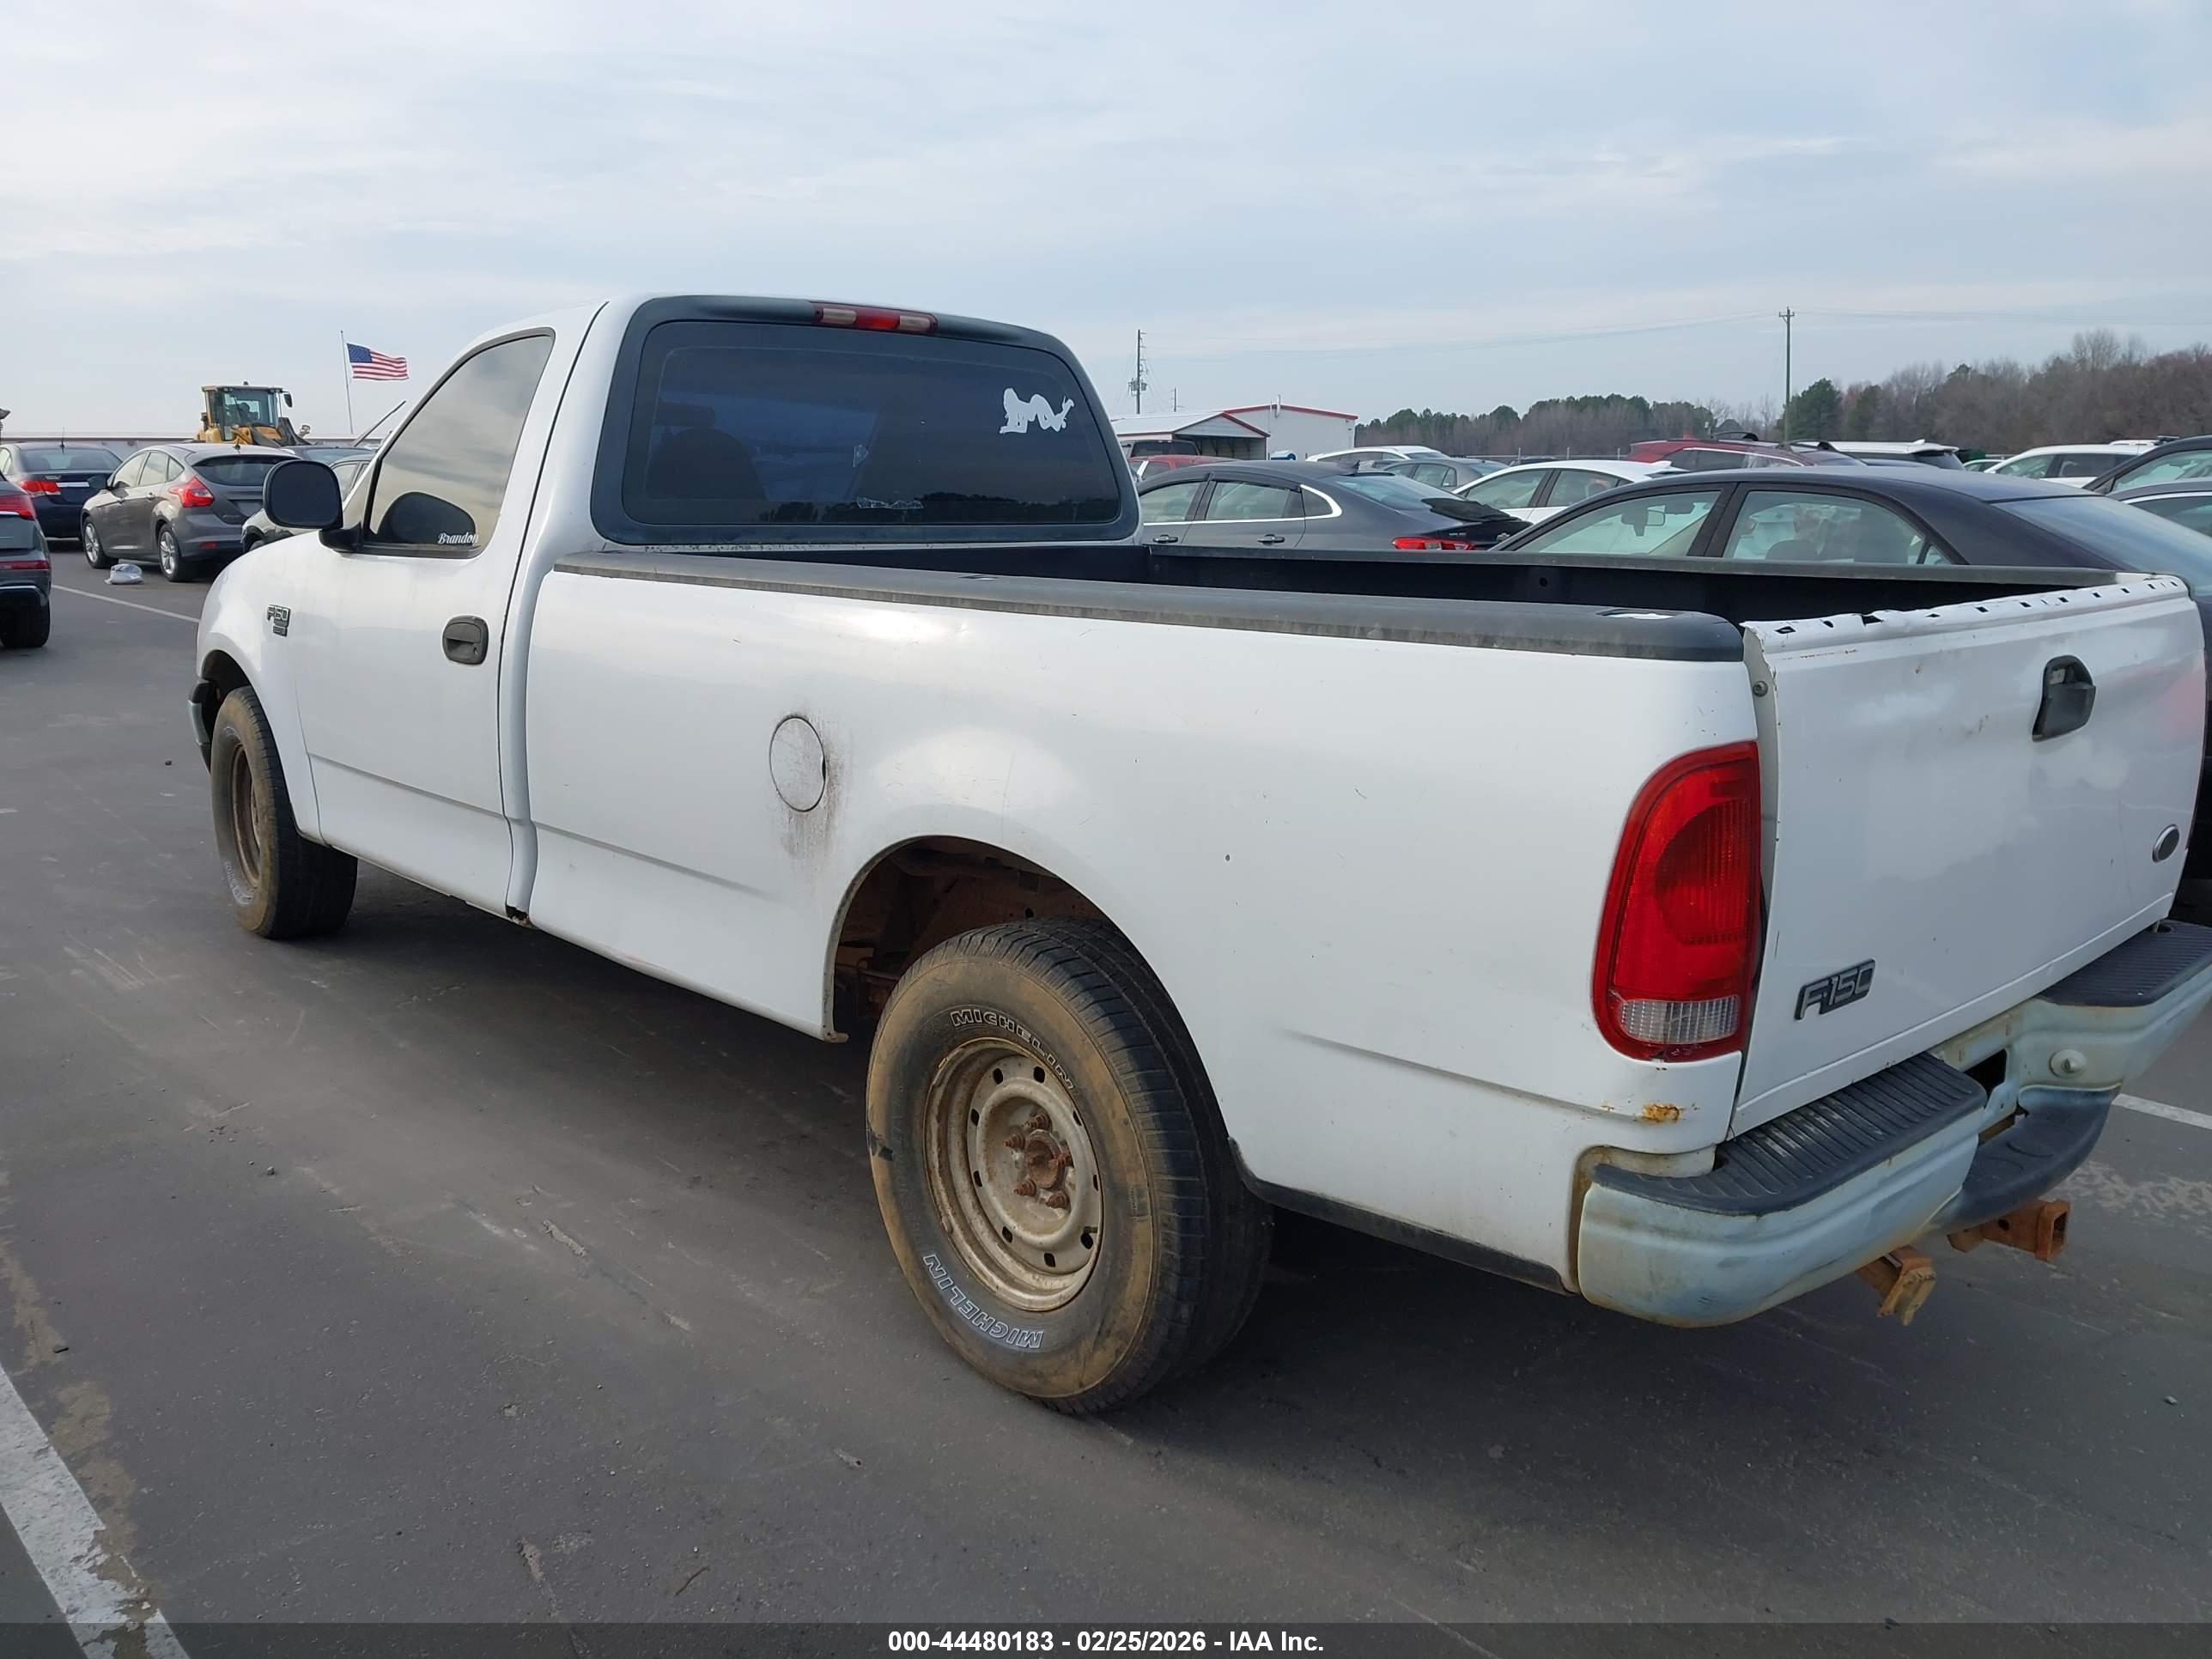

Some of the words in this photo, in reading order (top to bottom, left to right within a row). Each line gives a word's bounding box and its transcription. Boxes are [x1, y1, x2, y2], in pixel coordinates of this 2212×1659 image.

[438, 532, 479, 544] Brandon
[950, 1009, 1074, 1091] MICHELIN
[922, 1254, 1044, 1349] MICHELIN
